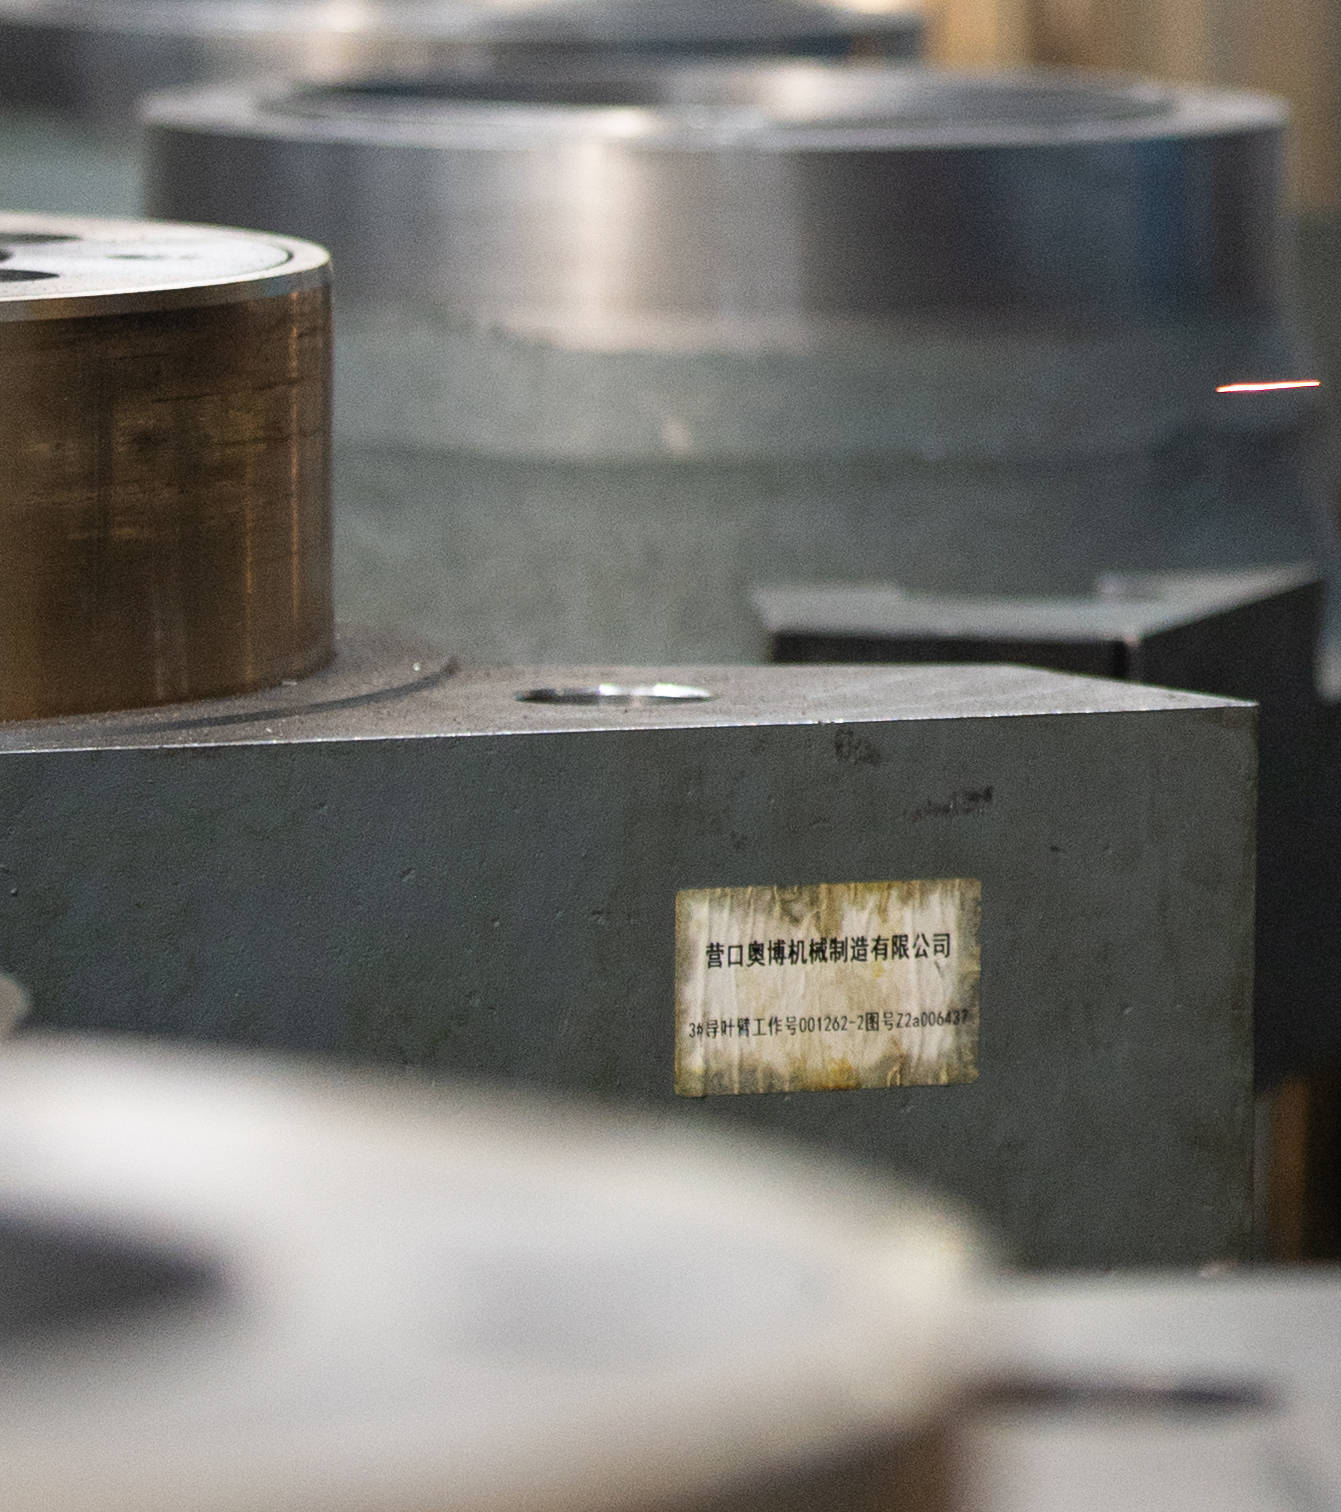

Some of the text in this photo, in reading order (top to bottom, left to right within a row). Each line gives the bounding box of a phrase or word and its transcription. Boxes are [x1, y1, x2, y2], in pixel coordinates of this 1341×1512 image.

[705, 932, 952, 970] 营口奥博机械制造有限公司
